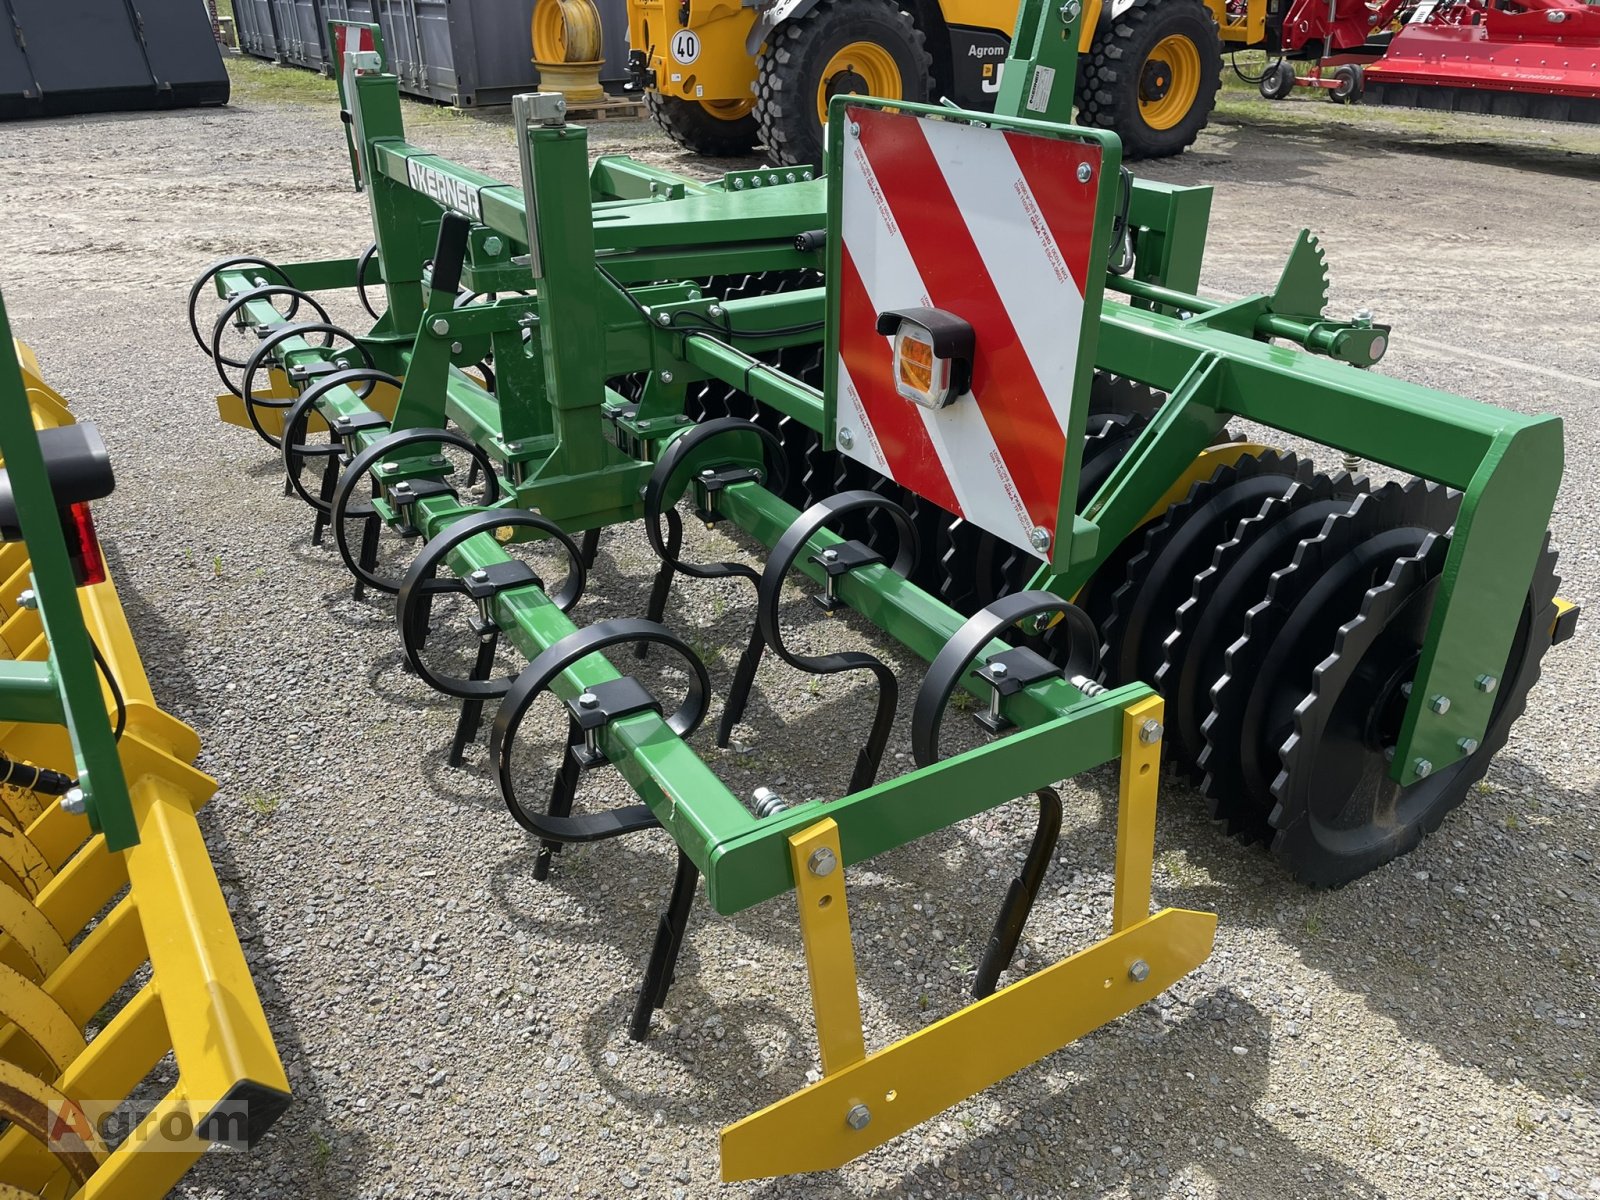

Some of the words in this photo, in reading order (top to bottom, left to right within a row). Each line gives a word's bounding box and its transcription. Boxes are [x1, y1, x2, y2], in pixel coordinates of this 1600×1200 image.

[677, 36, 695, 58] 40
[967, 44, 1004, 59] Agrom
[416, 163, 480, 219] KERNER
